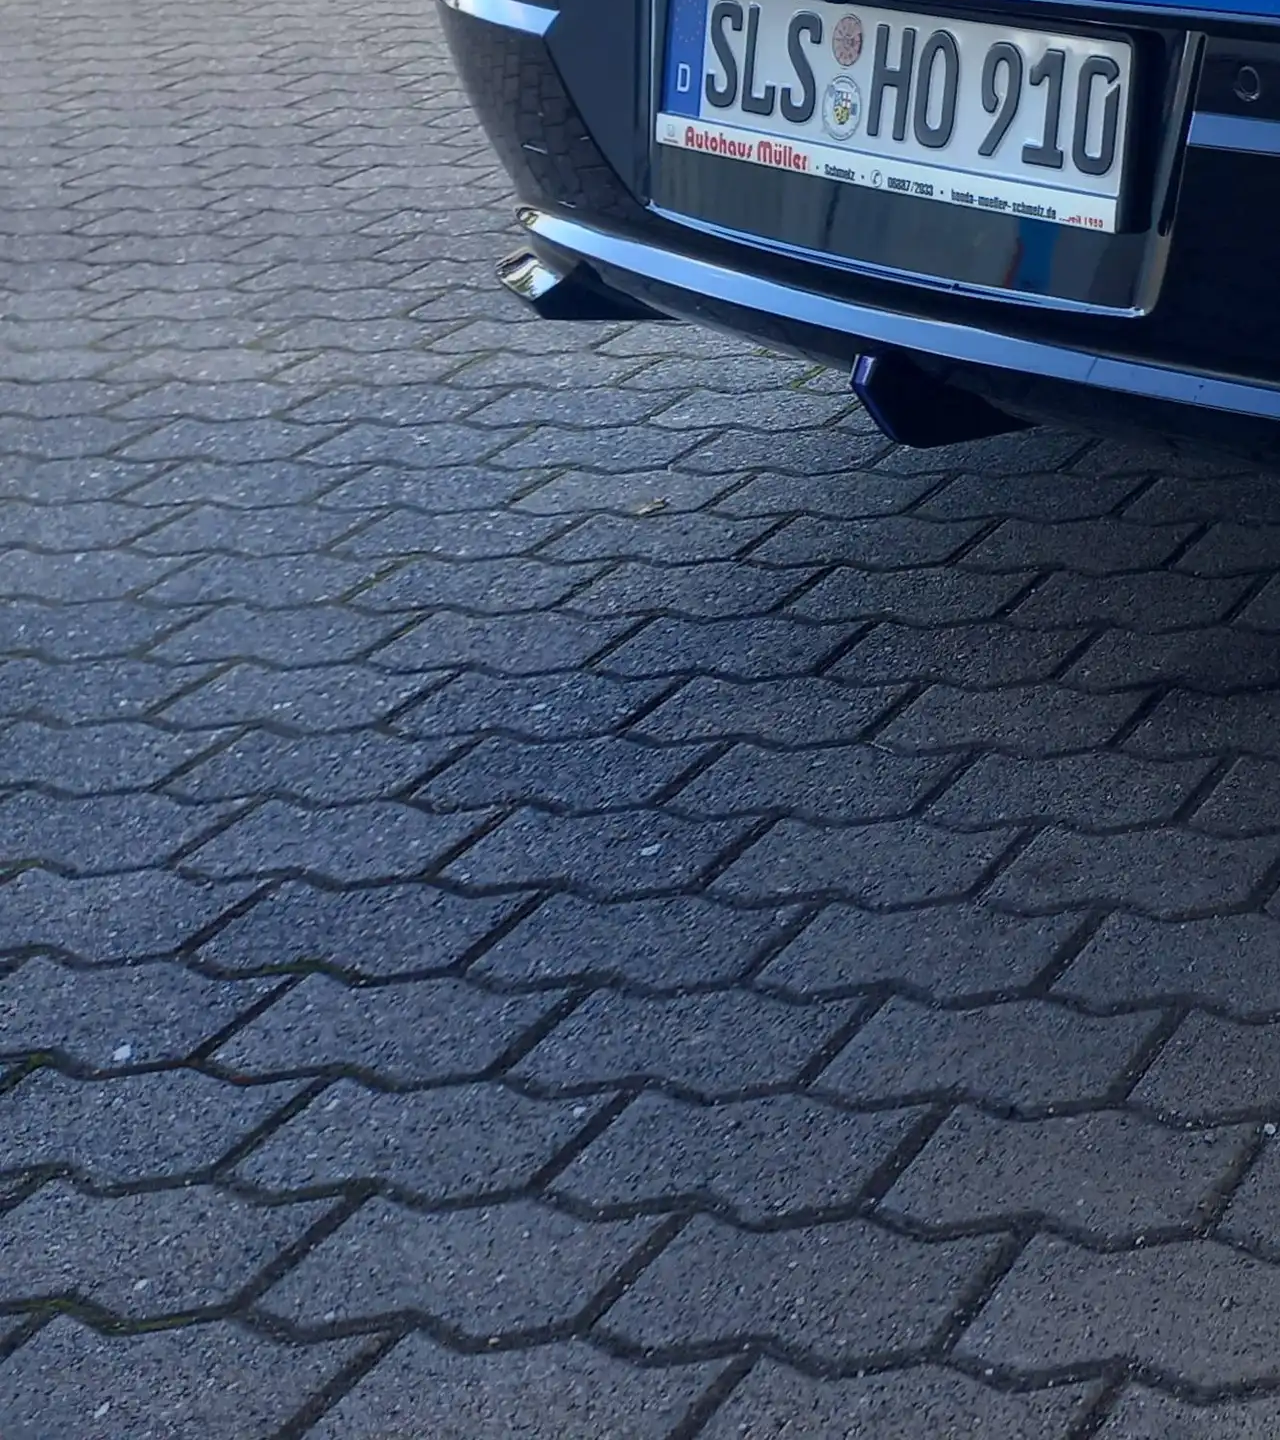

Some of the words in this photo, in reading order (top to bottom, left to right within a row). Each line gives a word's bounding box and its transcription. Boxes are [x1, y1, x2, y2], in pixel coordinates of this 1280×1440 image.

[676, 62, 692, 93] D
[866, 23, 961, 149] HO
[977, 41, 1122, 176] 910
[684, 125, 753, 160] Autohaus
[756, 139, 810, 172] Müller
[824, 163, 857, 182] Schmelz
